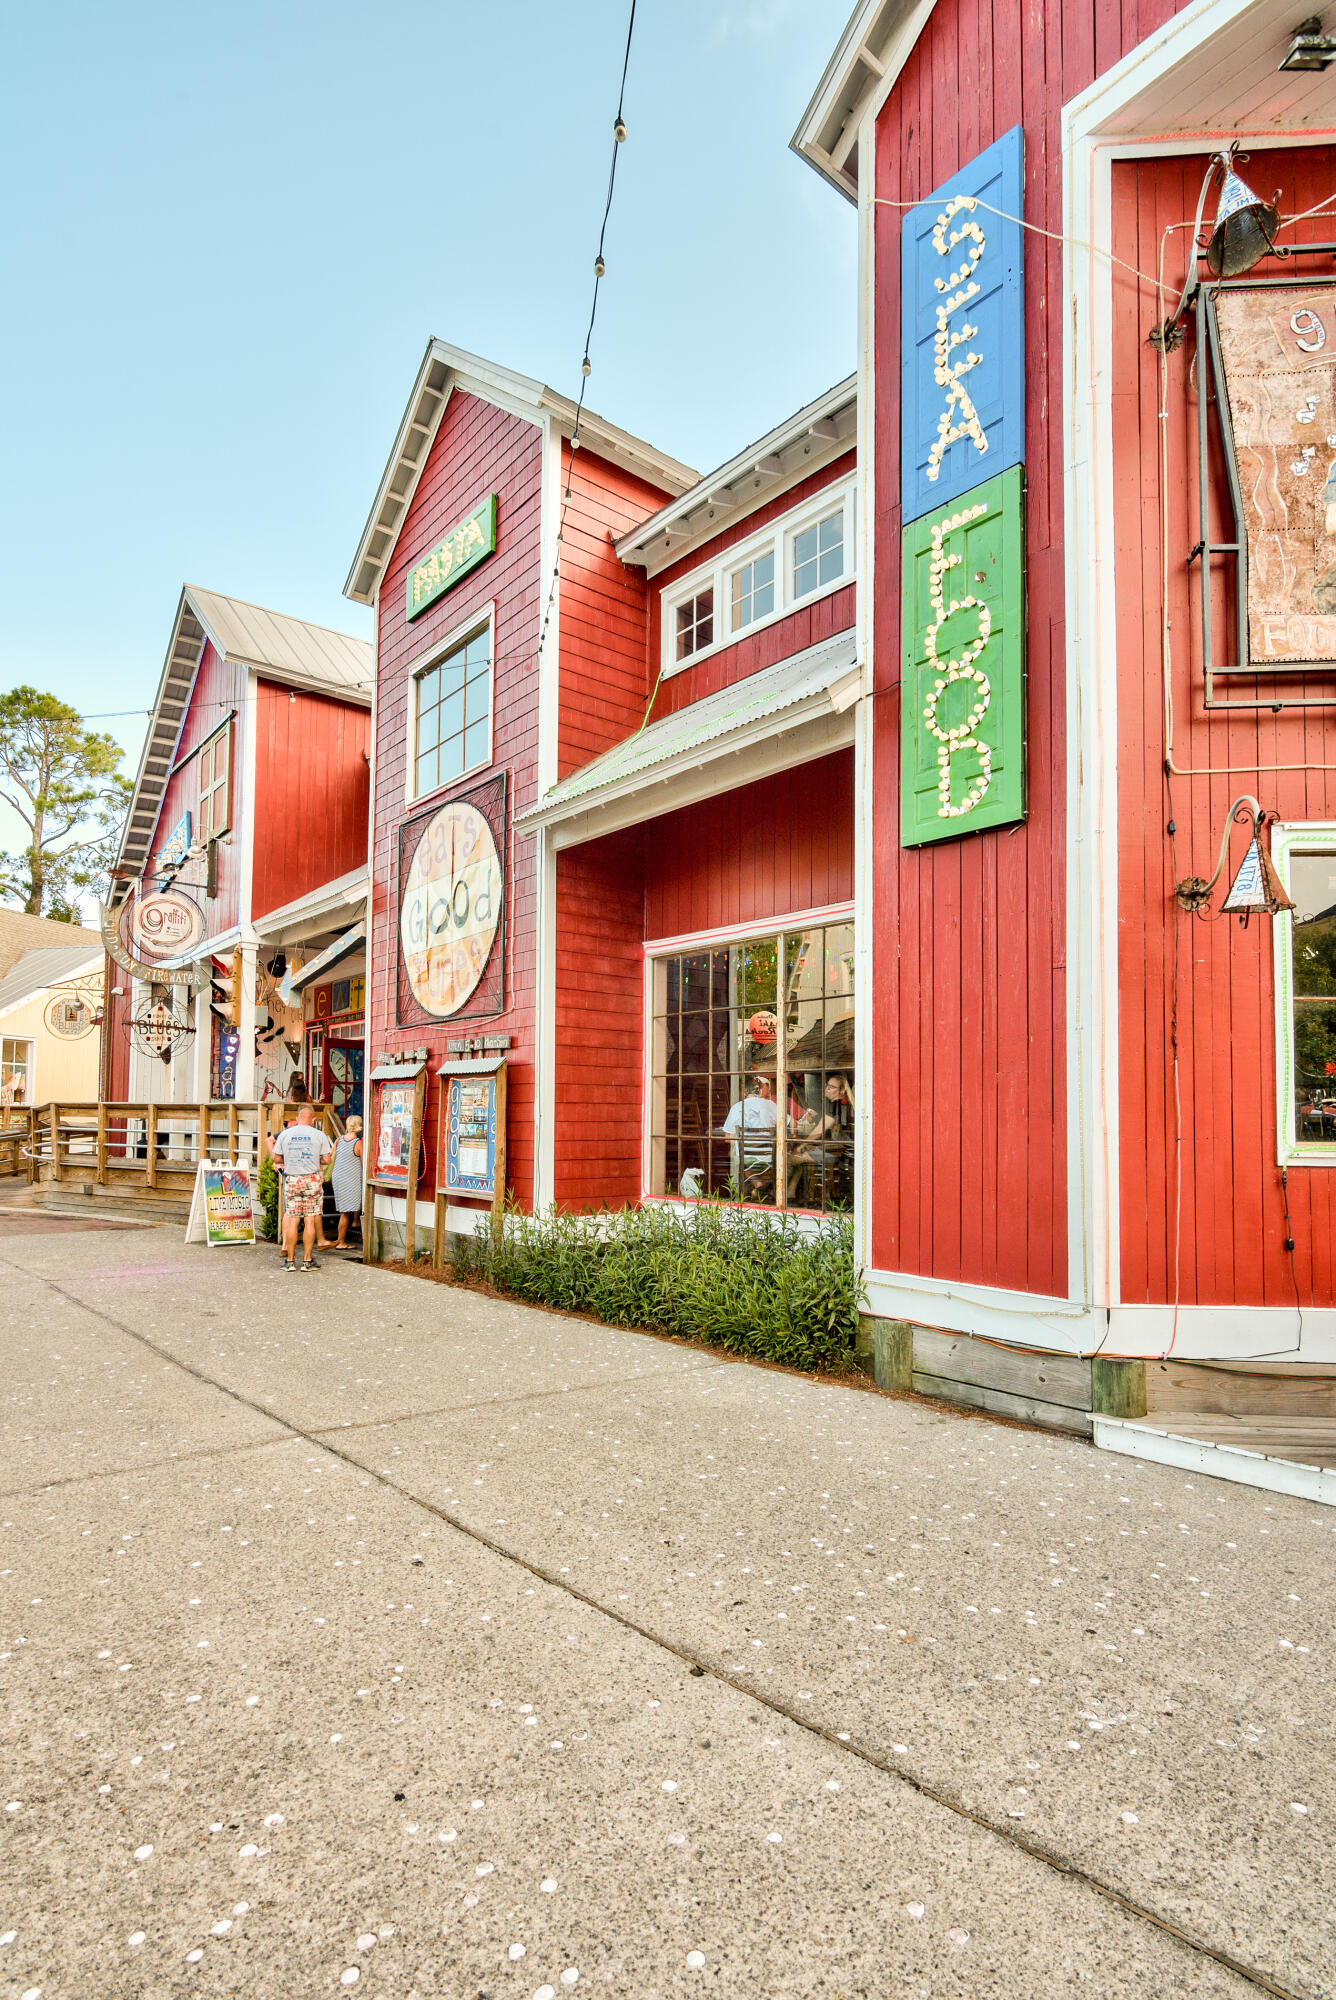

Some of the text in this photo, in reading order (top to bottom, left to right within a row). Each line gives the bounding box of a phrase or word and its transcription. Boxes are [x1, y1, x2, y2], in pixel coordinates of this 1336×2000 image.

[927, 194, 990, 482] SEA
[413, 518, 485, 603] PASTA
[924, 503, 992, 820] FOOD
[1260, 615, 1336, 656] FOO
[209, 1195, 250, 1211] LIVE MUSIC
[210, 1219, 252, 1231] HAPPY HOUR
